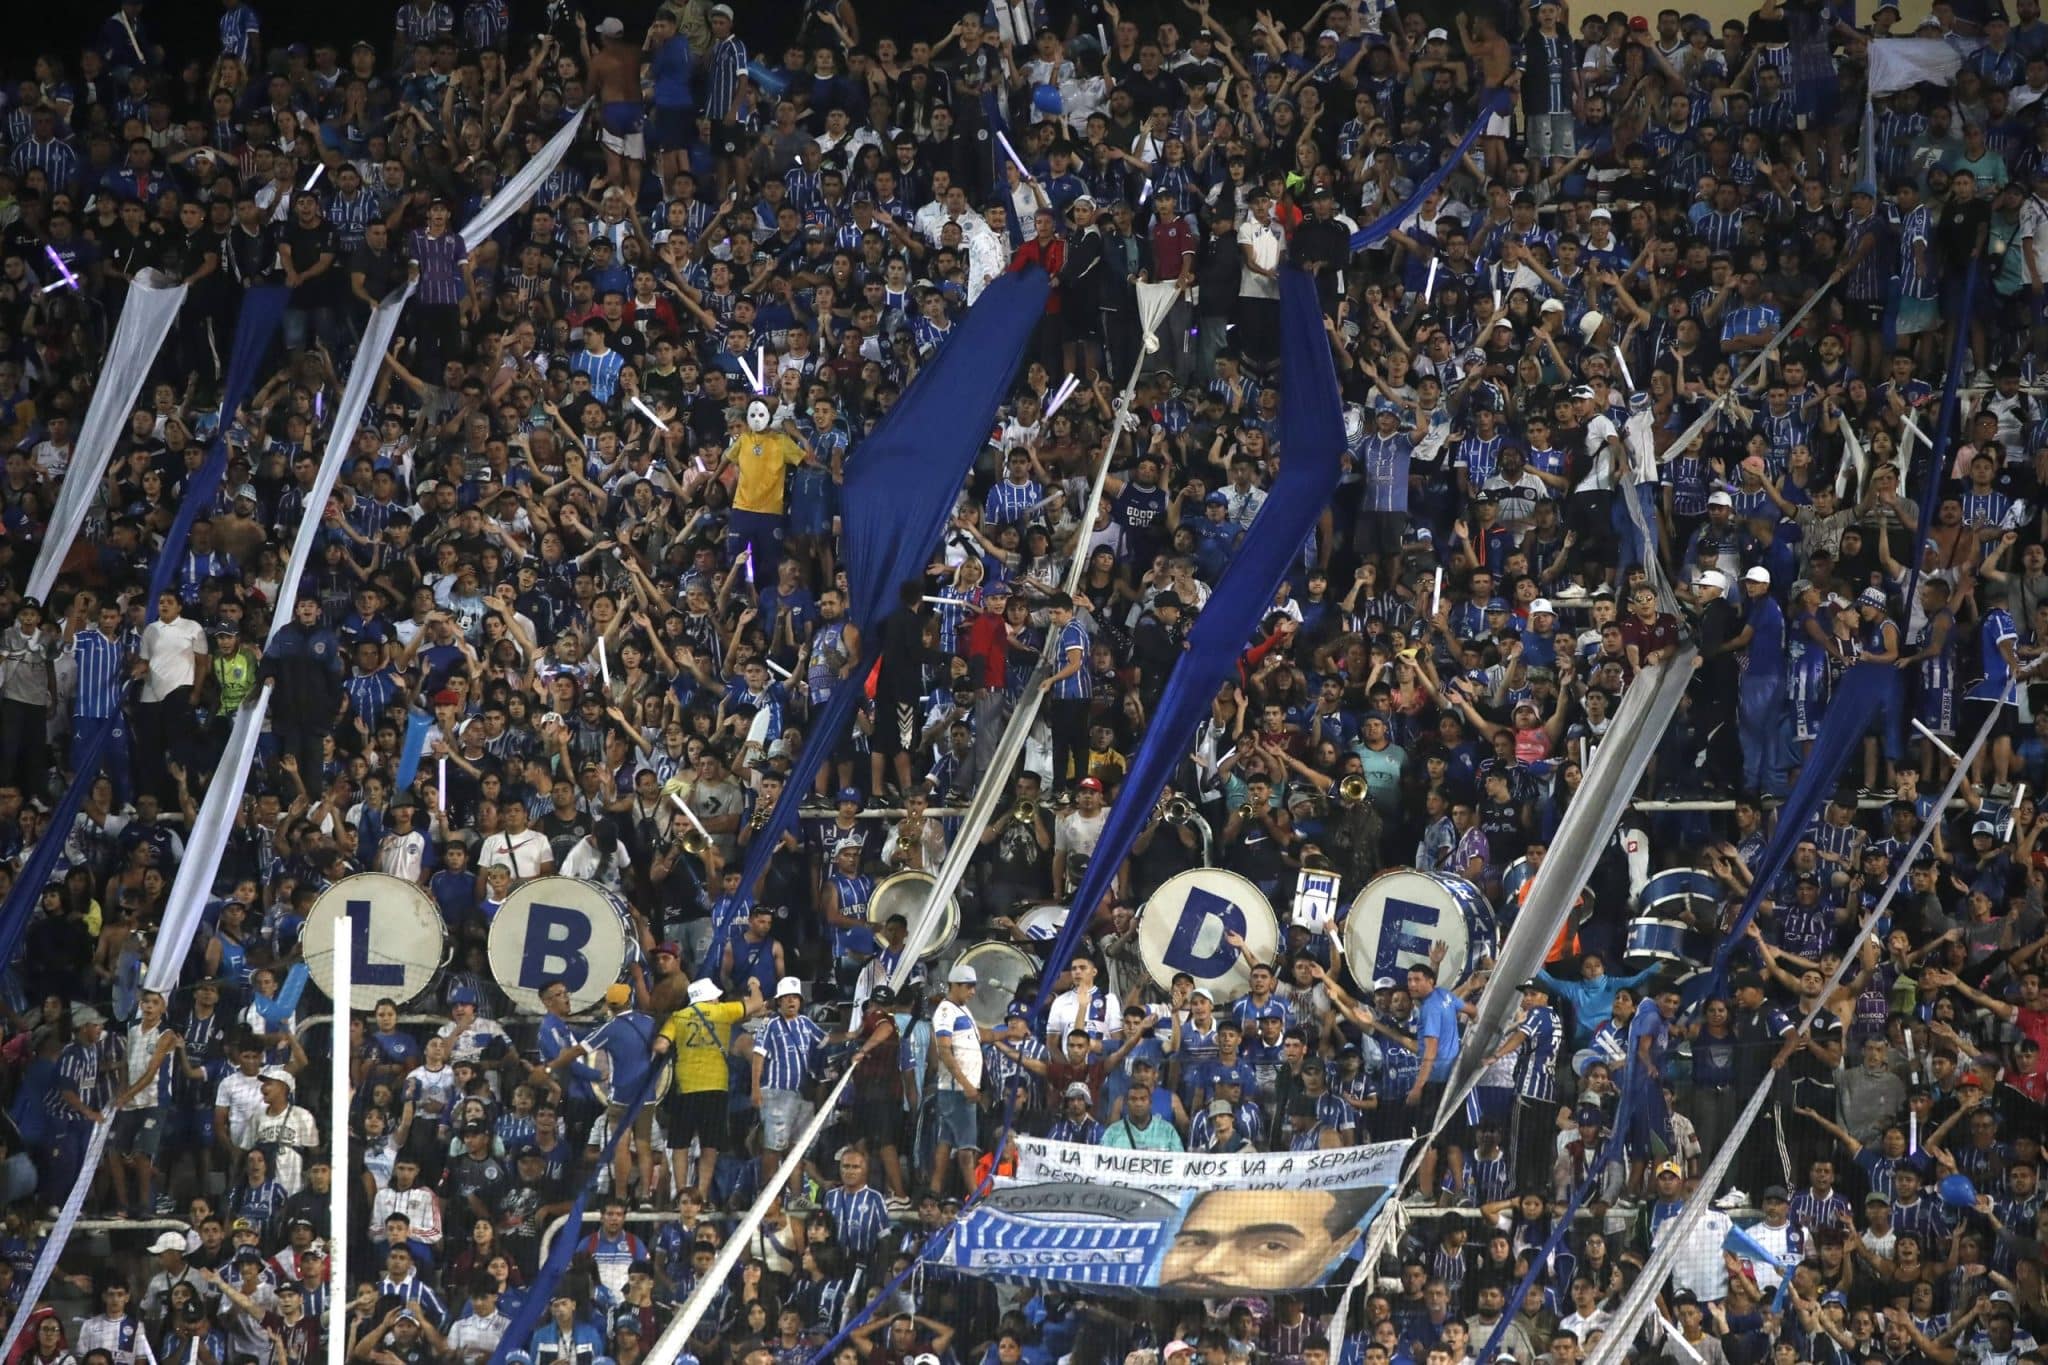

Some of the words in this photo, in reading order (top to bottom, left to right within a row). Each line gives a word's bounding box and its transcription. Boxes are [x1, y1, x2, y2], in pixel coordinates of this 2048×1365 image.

[347, 900, 405, 985] L
[518, 902, 592, 993] B
[1162, 886, 1246, 979] D
[1373, 897, 1440, 984] E
[1027, 1143, 1047, 1158] NI
[1060, 1149, 1082, 1166] LA
[1096, 1153, 1174, 1176] MUERTE
[1184, 1159, 1228, 1178] NOS
[1241, 1159, 1267, 1177] VA
[1279, 1157, 1295, 1175] A
[1082, 1193, 1141, 1215] CRUZ
